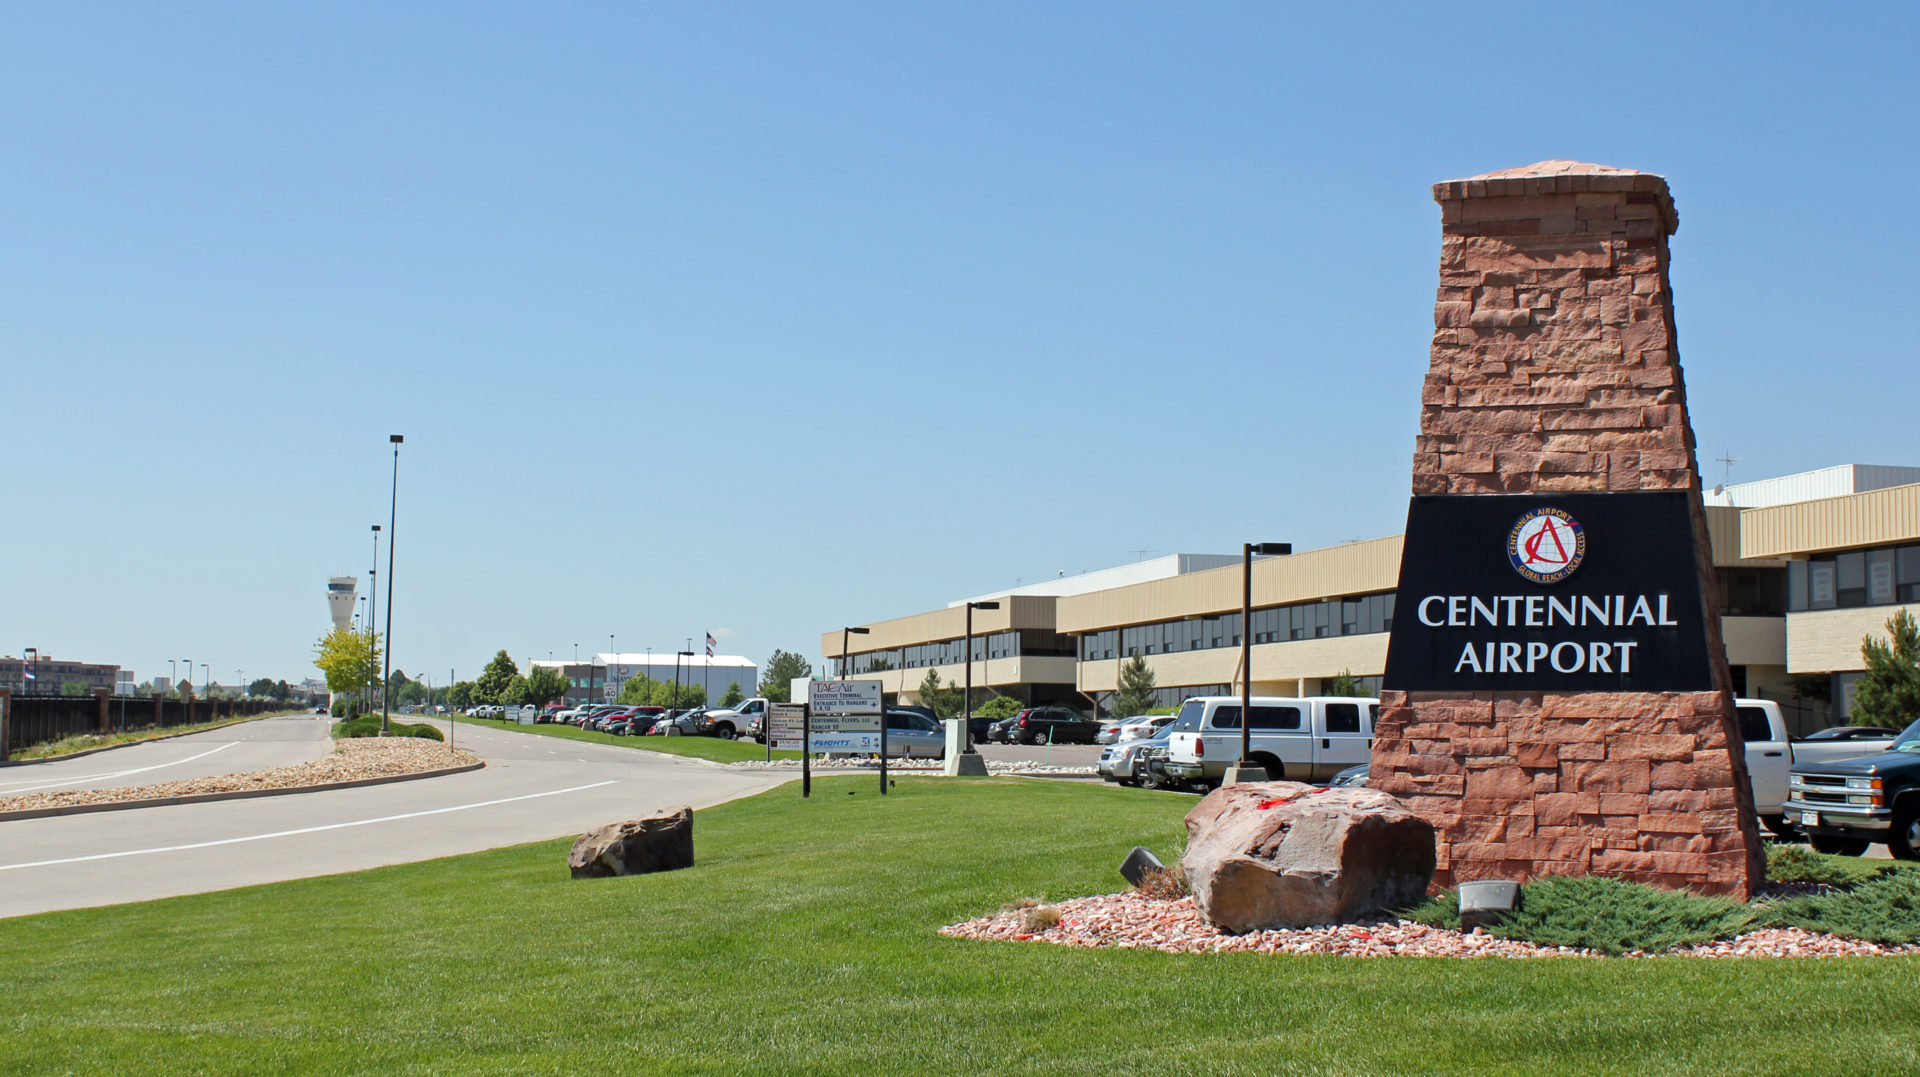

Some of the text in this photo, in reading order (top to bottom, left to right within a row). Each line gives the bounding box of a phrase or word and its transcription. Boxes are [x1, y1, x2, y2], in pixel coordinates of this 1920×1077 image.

[1509, 508, 1573, 555] CENTENNIAL AIRPORT
[1518, 531, 1585, 582] GLOBAL REACH LOCAL ACCESS
[1417, 594, 1678, 626] CENTENNIAL
[1454, 641, 1638, 673] AIRPORT
